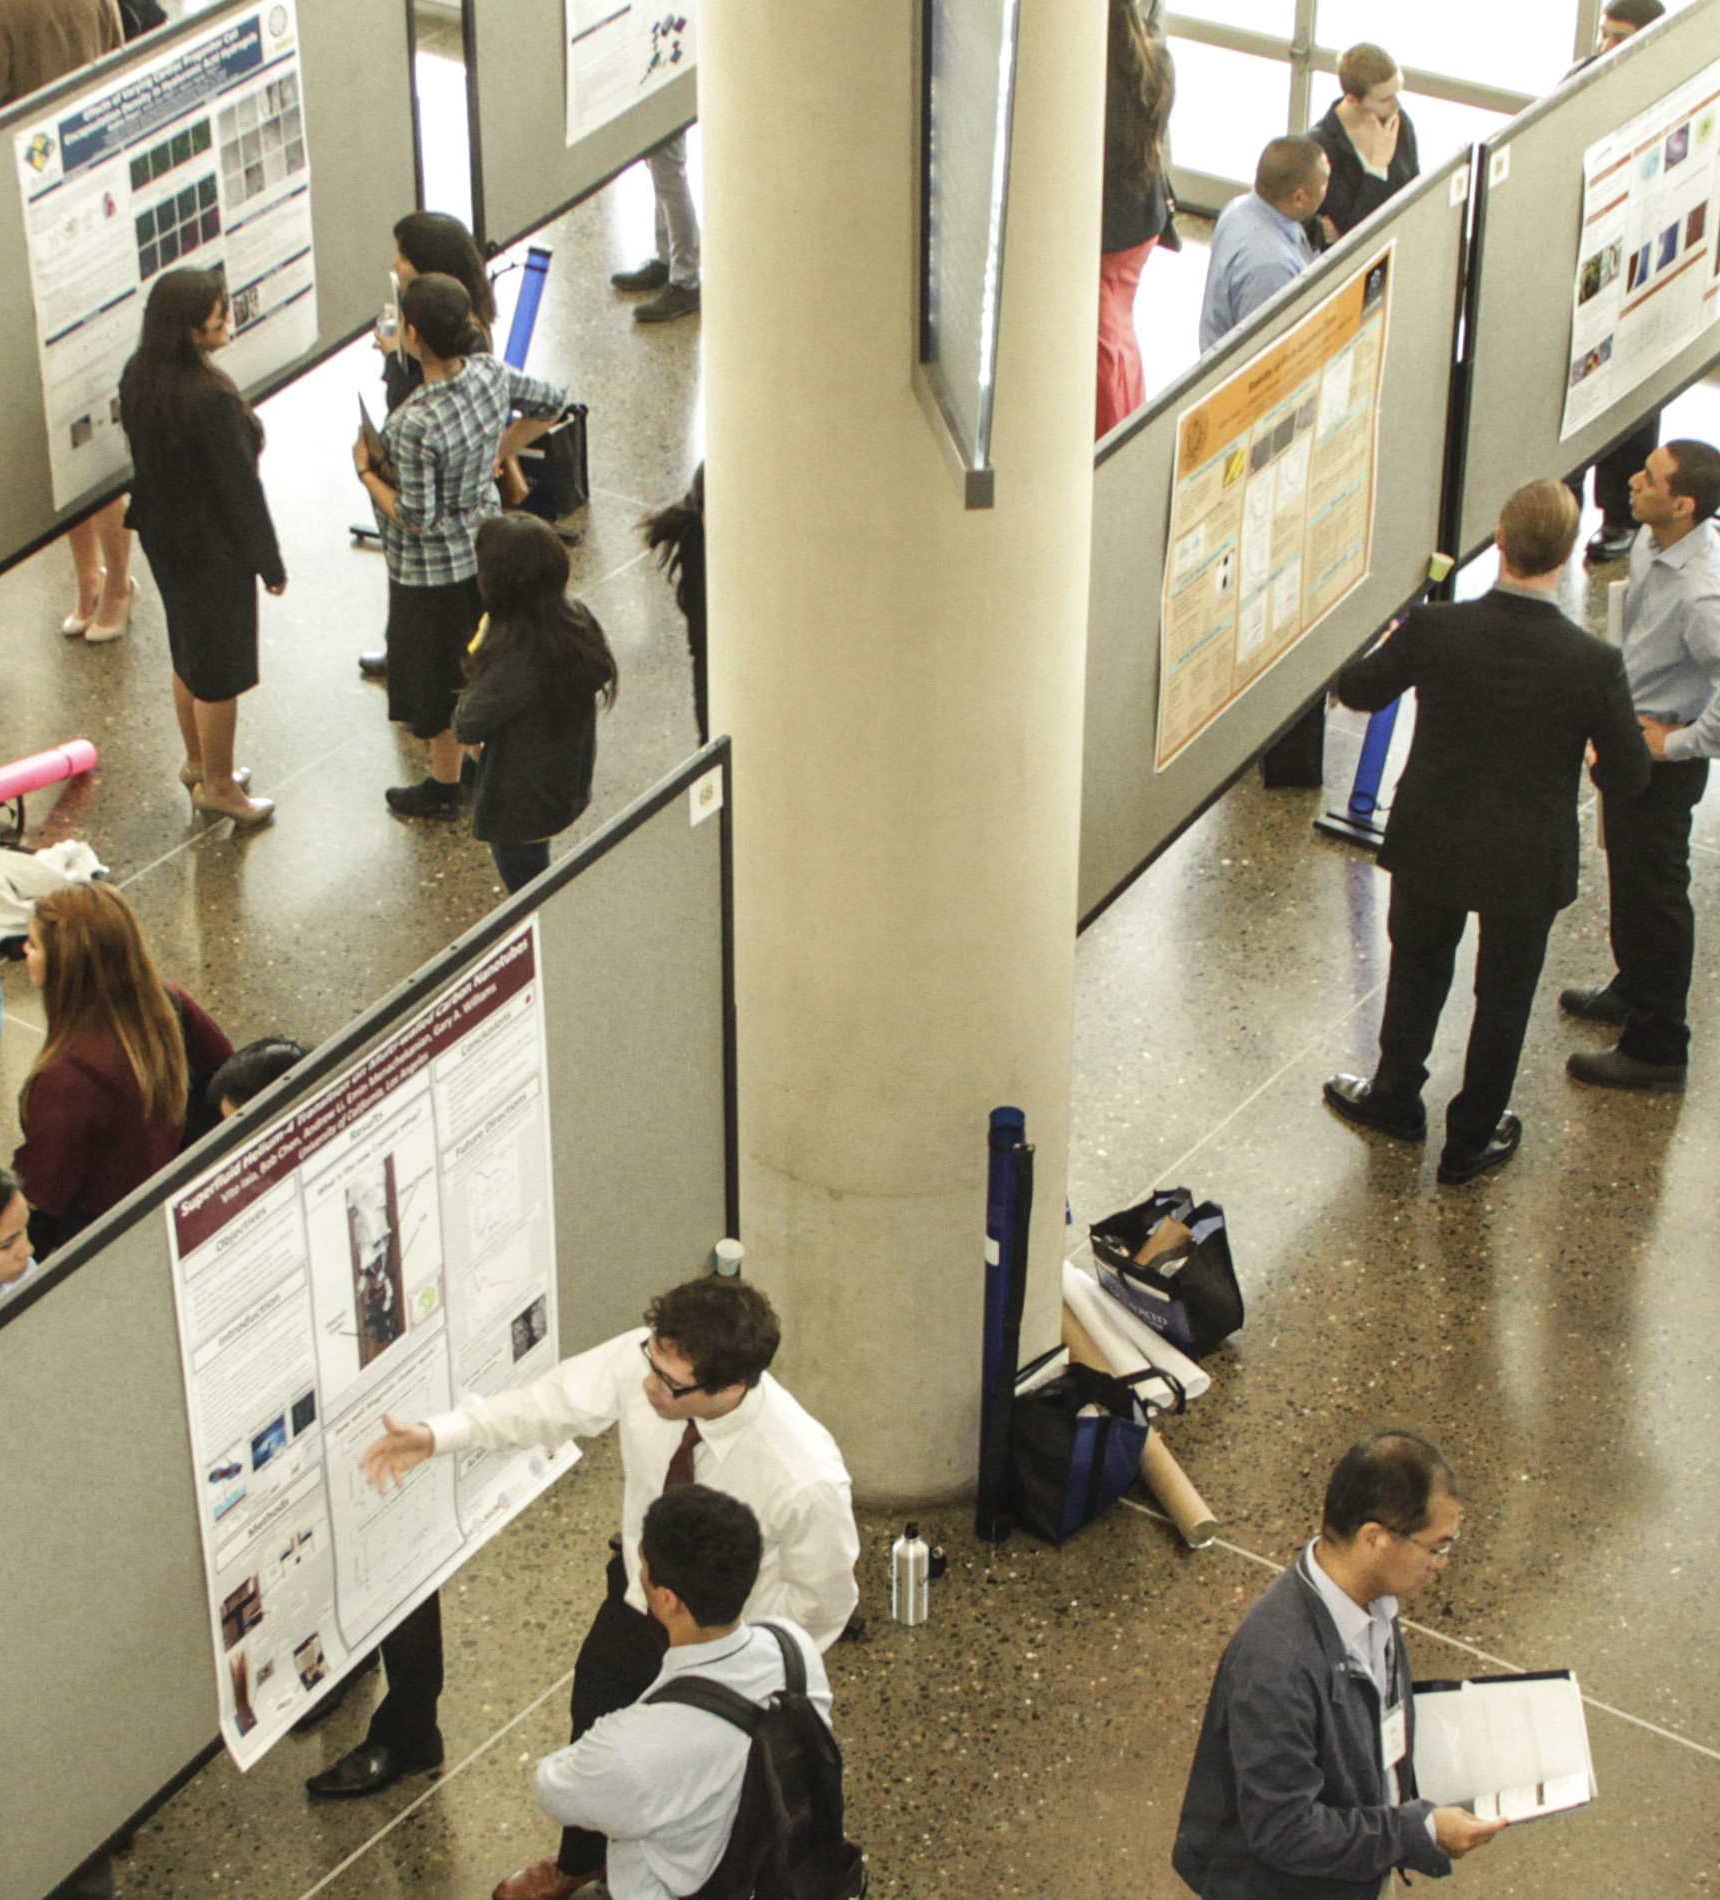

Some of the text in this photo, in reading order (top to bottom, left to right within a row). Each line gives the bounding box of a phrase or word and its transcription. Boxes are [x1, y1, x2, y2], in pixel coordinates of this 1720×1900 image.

[432, 1016, 453, 1037] Gary
[462, 982, 497, 1013] Williams
[460, 1011, 512, 1057] Conclusions
[180, 1160, 242, 1217] Superfluid
[241, 1120, 295, 1170] Helium-4
[296, 1079, 351, 1126] Transition
[351, 1066, 367, 1084] on
[435, 982, 472, 1017] Carbon
[473, 938, 529, 988] Nanotubes
[298, 1124, 337, 1160] University
[349, 1111, 383, 1141] Results
[455, 1093, 527, 1158] Future Directions
[215, 1206, 267, 1253] Objectives
[218, 1293, 281, 1346] Introduction
[247, 1498, 290, 1538] Methods
